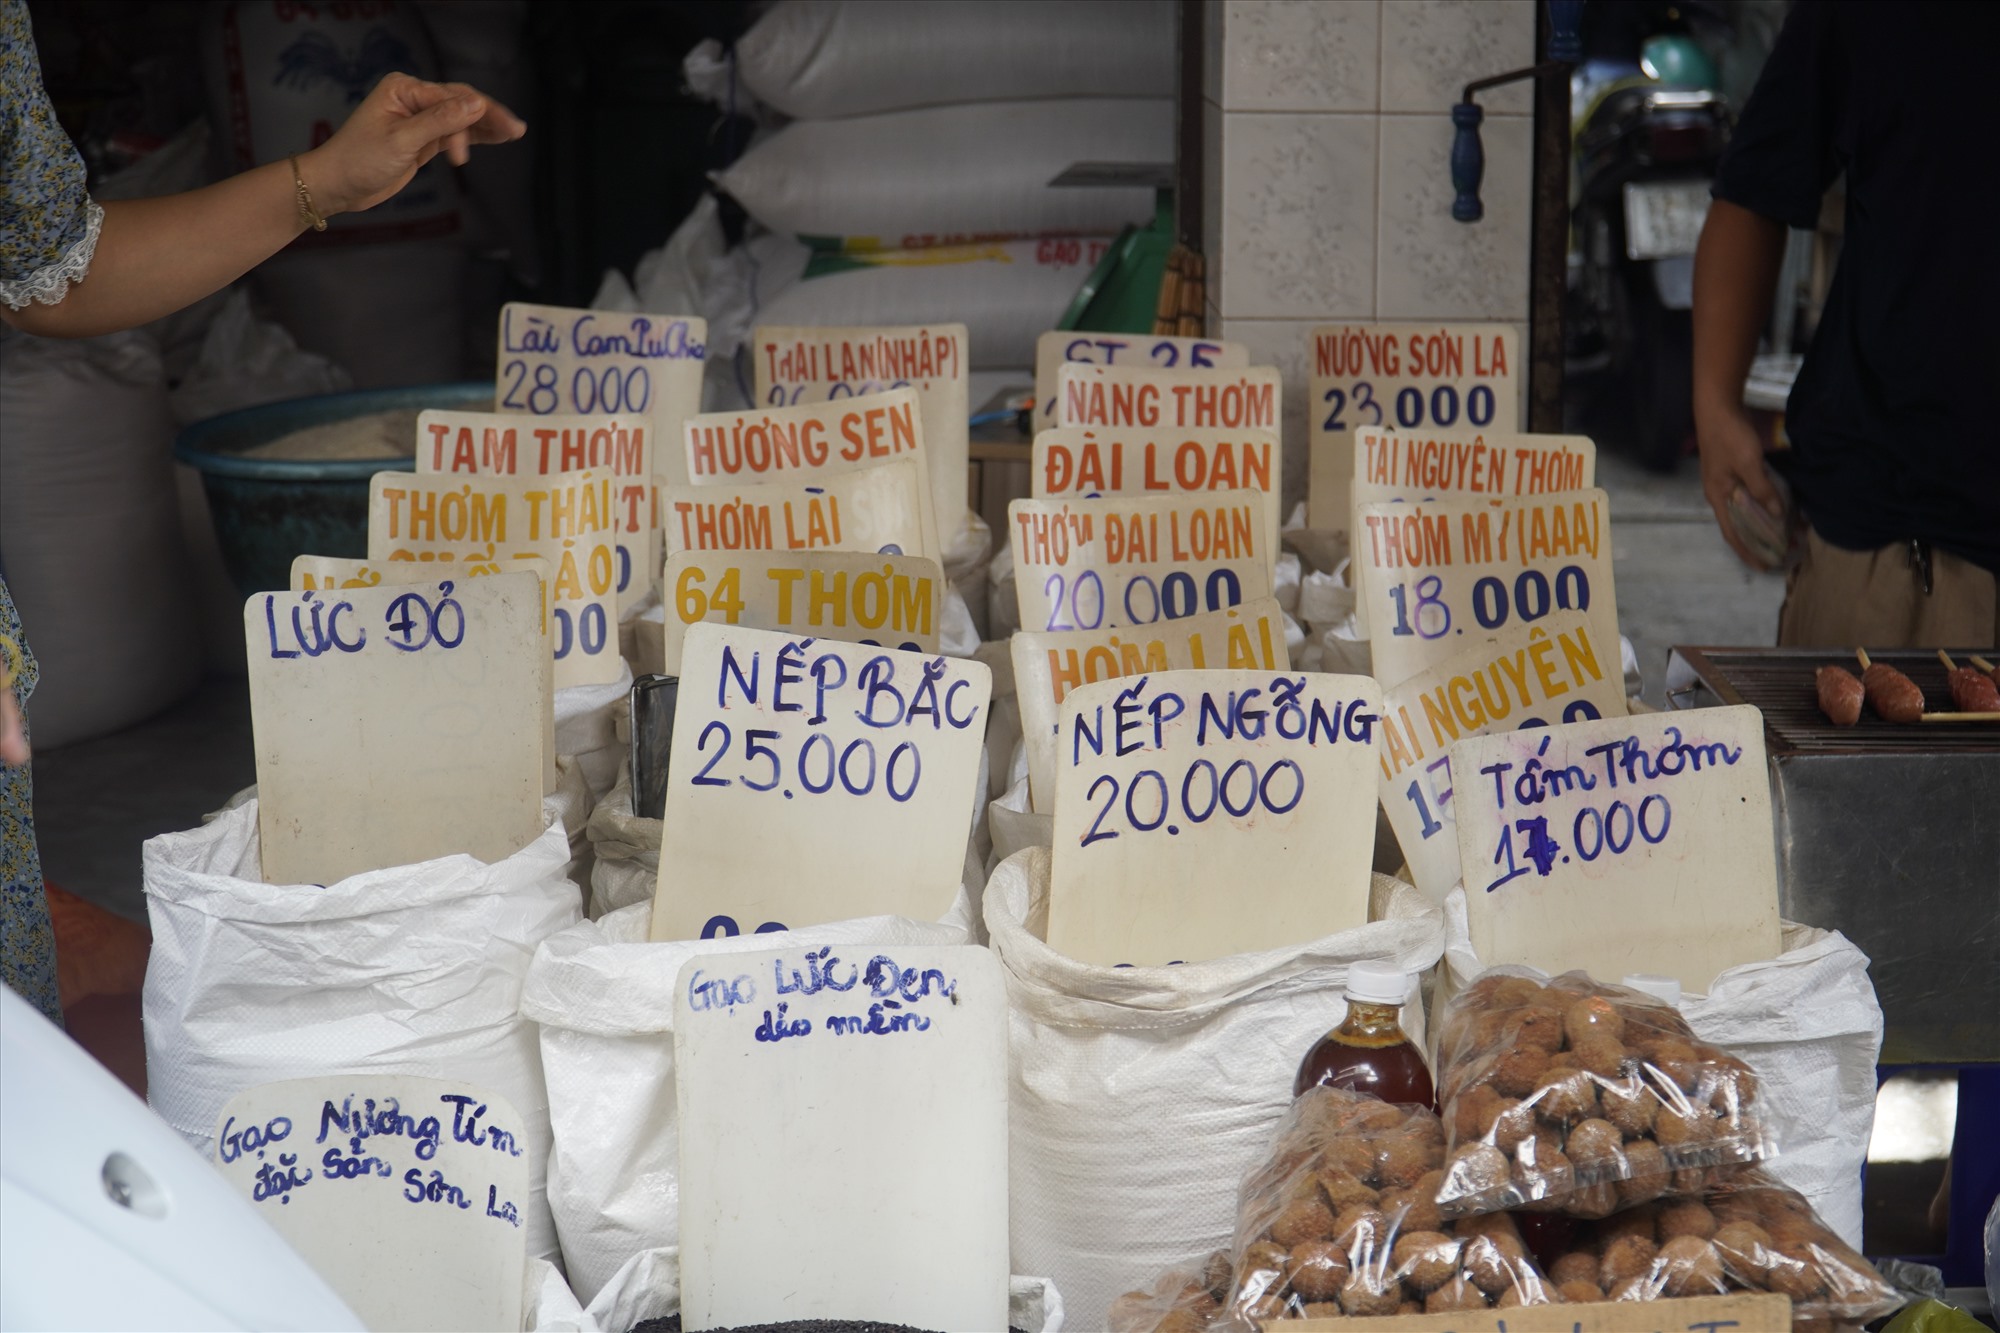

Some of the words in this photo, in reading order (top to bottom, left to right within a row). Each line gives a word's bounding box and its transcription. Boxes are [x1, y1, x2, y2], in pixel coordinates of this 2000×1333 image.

[1316, 327, 1400, 378] NƯƠNG
[1409, 329, 1464, 378] SƠN
[1474, 335, 1509, 378] LA
[1067, 369, 1160, 427] NÀNG
[1172, 377, 1275, 429] THƠM
[428, 423, 518, 475] TAM
[534, 421, 645, 476] THƠM
[691, 416, 830, 475] HƯƠNG
[840, 402, 918, 462] SEN
[1045, 432, 1124, 494] ĐÀI
[1145, 441, 1271, 492] LOAN
[1405, 435, 1507, 495] NGUYÊN
[1515, 445, 1586, 496] THƠM
[383, 484, 508, 543] THƠM
[523, 471, 611, 541] THÁI
[675, 496, 773, 550] THƠM
[784, 486, 842, 550] LÀI
[1105, 513, 1158, 564] ĐAI
[1170, 505, 1254, 563] LOAN
[1366, 506, 1452, 568] THƠM
[1461, 500, 1512, 565] MỸ
[1517, 501, 1600, 567] (AAA)
[385, 580, 465, 652] ĐỎ
[675, 566, 745, 625] 64
[767, 564, 933, 637] THƠM
[1389, 565, 1590, 640] 18.000
[718, 637, 847, 727] NẾP
[855, 656, 979, 730] BẮC
[1419, 625, 1604, 748] NGUYÊN
[1074, 676, 1186, 767] NẾP
[1197, 676, 1382, 746] NGỖNG
[691, 721, 922, 803] 25.000
[1481, 735, 1597, 809] Tấm
[1081, 759, 1305, 847] 20.000
